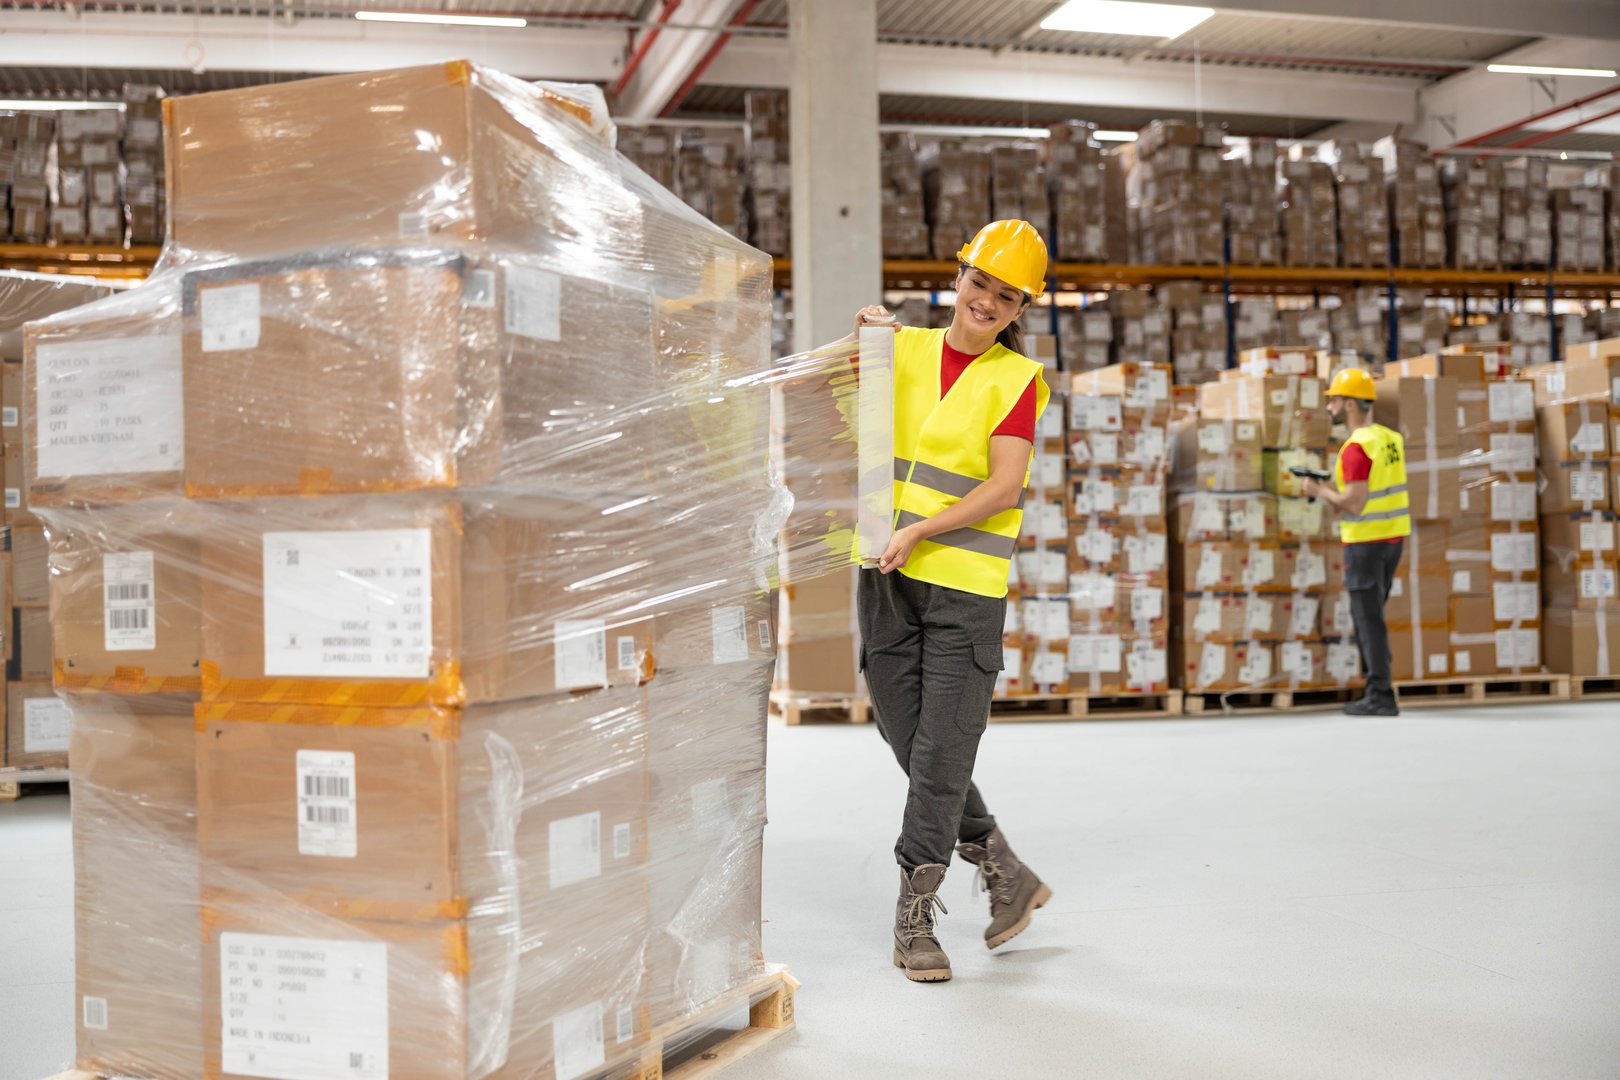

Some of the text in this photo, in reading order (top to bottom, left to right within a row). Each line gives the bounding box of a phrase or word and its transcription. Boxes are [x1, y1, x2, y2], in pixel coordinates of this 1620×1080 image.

[90, 431, 134, 444] VIETNAM
[229, 992, 248, 1004] SIZE
[229, 1008, 245, 1018] QTY
[229, 1027, 311, 1045] MADE IN INDONESIA
